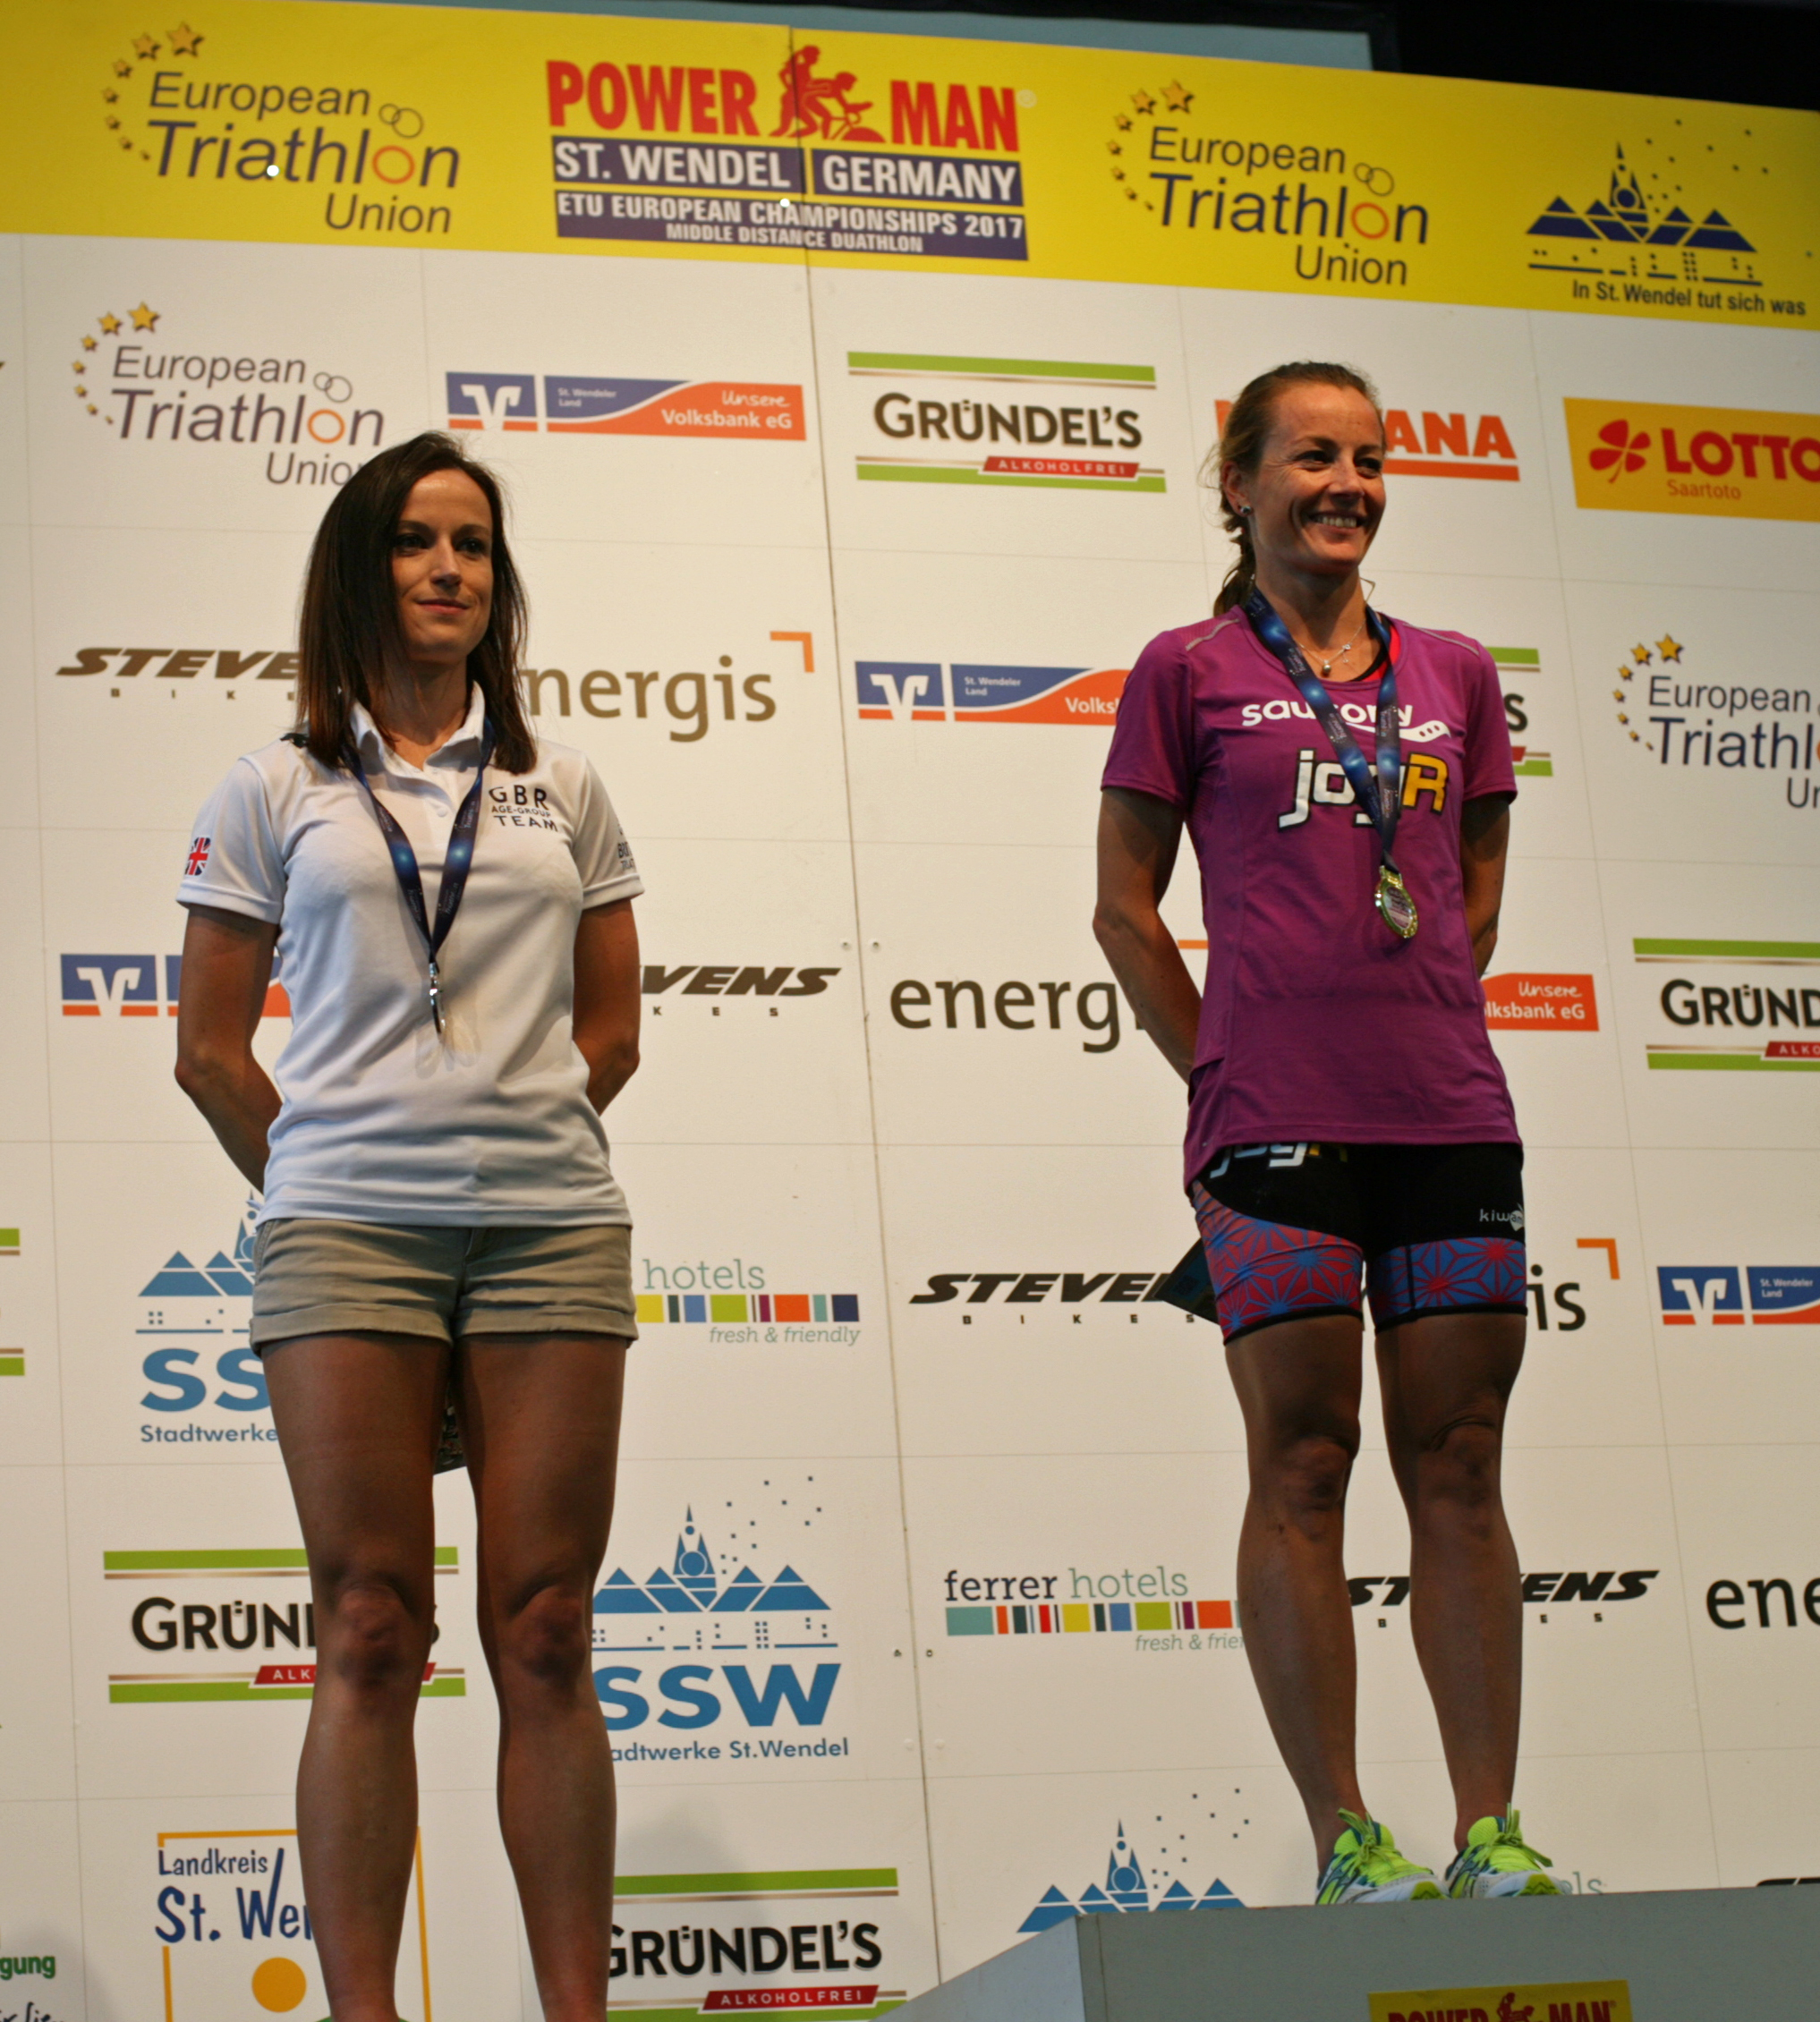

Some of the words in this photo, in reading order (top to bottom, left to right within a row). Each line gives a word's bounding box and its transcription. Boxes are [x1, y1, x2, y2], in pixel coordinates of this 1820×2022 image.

[149, 72, 370, 119] European
[547, 60, 761, 136] POWER
[890, 80, 1020, 152] MAN
[147, 121, 460, 188] Triathlon
[1150, 126, 1346, 176] European
[555, 141, 611, 179] ST.
[619, 144, 791, 188] WENDEL
[821, 155, 1016, 200] GERMANY
[325, 193, 451, 233] Union
[557, 191, 604, 216] ETU
[611, 195, 742, 223] EUROPEAN
[749, 202, 958, 236] CHAMPIONSHIPS
[964, 216, 1024, 239] 2017
[1150, 172, 1429, 244] Triathlon
[666, 224, 734, 242] MIDDLE
[737, 226, 826, 248] DISTANCE
[830, 232, 923, 253] DUATHLON
[1296, 245, 1408, 285] Union
[1572, 280, 1589, 299] In
[1596, 282, 1618, 301] St.
[1624, 285, 1692, 307] Wendel
[1697, 291, 1722, 309] tut
[1727, 294, 1765, 312] sich
[1771, 300, 1807, 316] was
[113, 345, 306, 389] European
[557, 388, 572, 398] St.
[573, 388, 617, 399] Wendeler
[558, 399, 582, 407] Land
[722, 390, 791, 408] Unsere
[111, 388, 385, 446] Triathlon
[661, 409, 761, 428] Volksbank
[766, 412, 792, 429] eG
[873, 391, 1143, 449] GRÜNDEL'S
[266, 451, 362, 486] Unio
[998, 459, 1126, 475] ALKOHOLFREI
[1661, 427, 1820, 483] LOTTO
[1667, 480, 1742, 501] Saartoto
[964, 675, 977, 686] St.
[979, 676, 1021, 688] Wendeler
[965, 686, 988, 696] Land
[1648, 675, 1811, 717] European
[1648, 716, 1820, 770] Triathl
[489, 784, 549, 811] GBR
[491, 806, 551, 819] AGE-GROUP
[493, 815, 558, 832] TEAM
[1518, 981, 1583, 998] Unsere
[889, 980, 1144, 1053] energ
[1484, 1000, 1556, 1019] lksbank
[1561, 1004, 1586, 1019] eG
[642, 1259, 766, 1290] hotels
[1773, 1279, 1813, 1287] Wendeler
[1762, 1289, 1782, 1297] Land
[963, 1314, 1195, 1324] BIKES
[710, 1328, 759, 1343] fresh
[765, 1328, 778, 1343] &
[784, 1327, 861, 1347] friendly
[140, 1423, 278, 1442] Stadtwerke
[945, 1570, 1058, 1601] ferrer
[1068, 1566, 1188, 1599] hotels
[1135, 1634, 1182, 1652] fresh
[1188, 1634, 1202, 1651] &
[592, 1663, 841, 1731] SSW
[729, 1737, 849, 1759] St.Wendel
[158, 1848, 268, 1876] Landkreis
[155, 1885, 221, 1943] St.
[720, 1991, 862, 2006] ALKOHOLFREI
